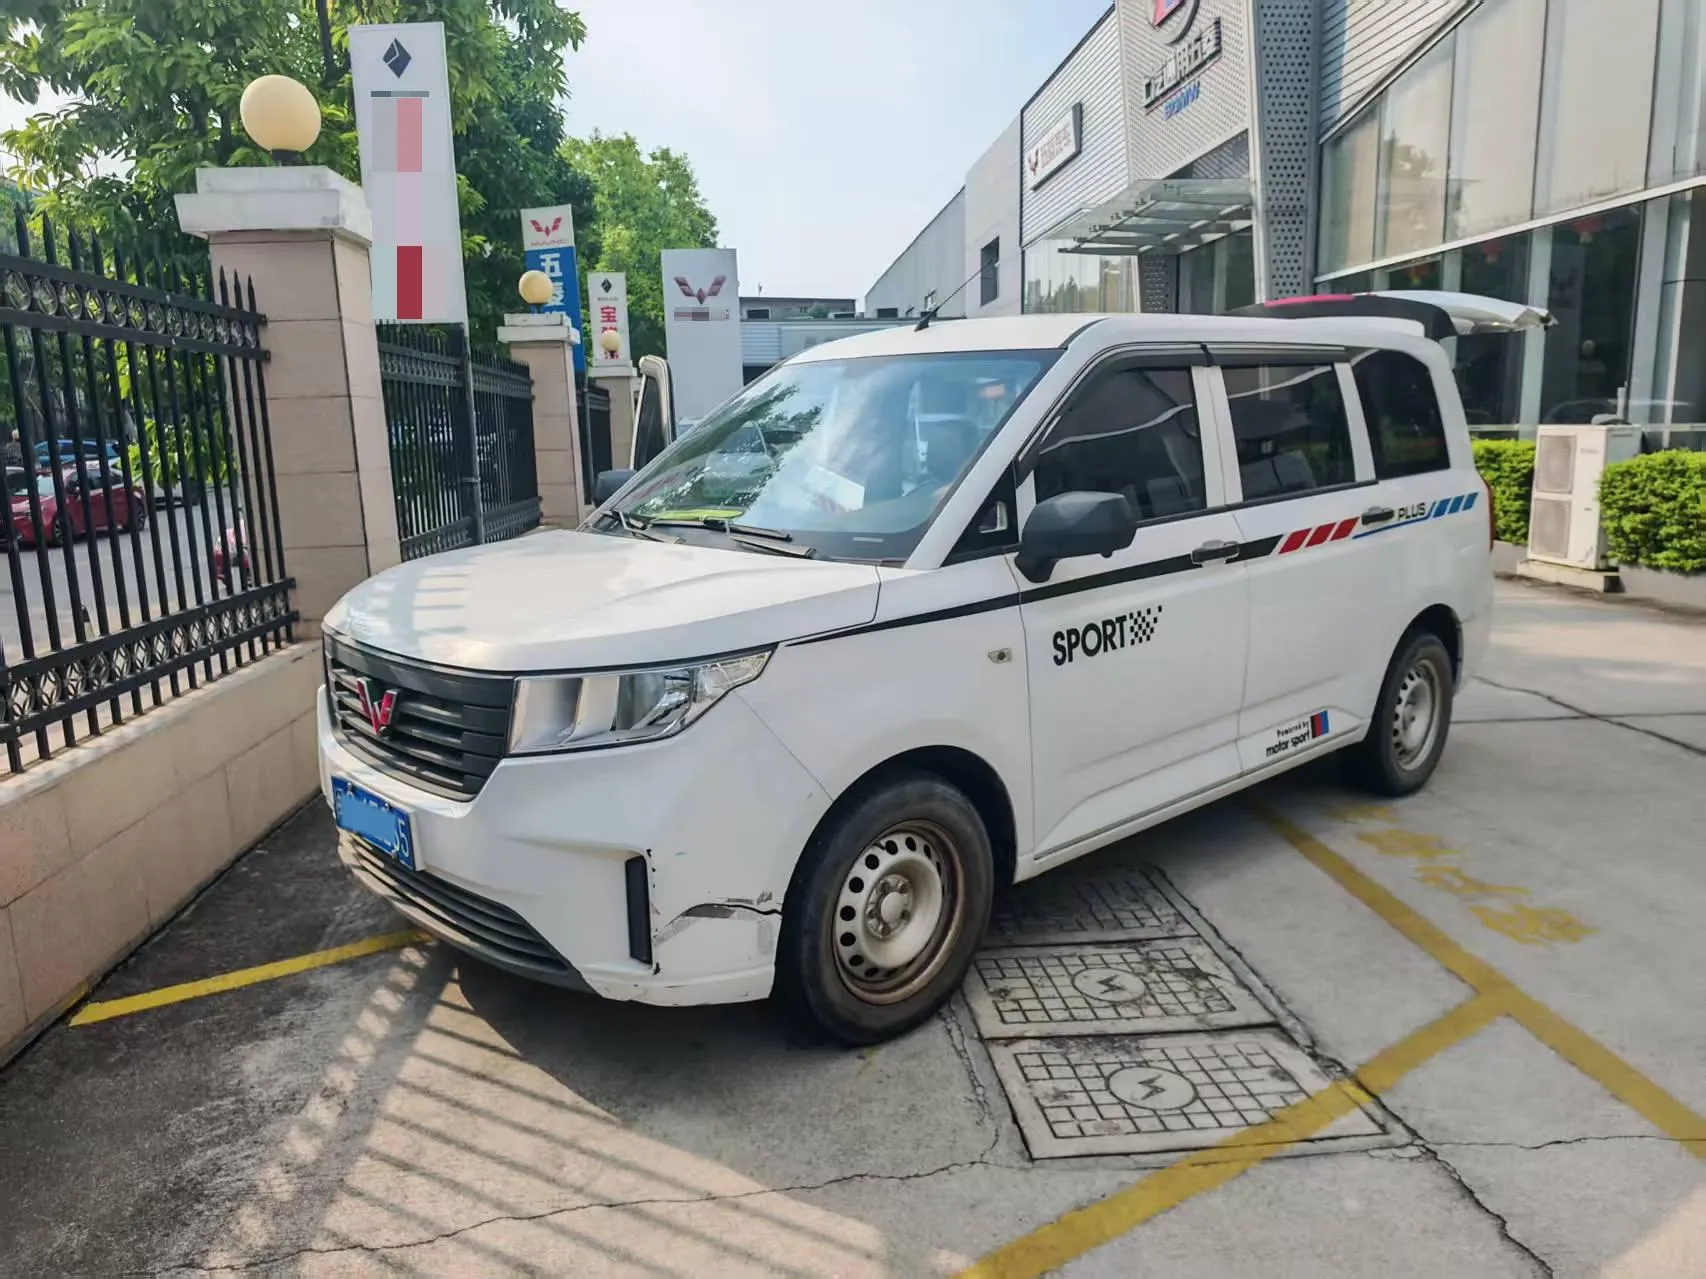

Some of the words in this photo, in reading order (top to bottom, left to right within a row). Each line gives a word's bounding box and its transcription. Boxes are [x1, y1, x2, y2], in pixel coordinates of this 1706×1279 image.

[1398, 502, 1426, 520] PLUS
[1053, 615, 1127, 666] SPORT
[1265, 740, 1290, 757] motor
[1290, 730, 1310, 748] sport
